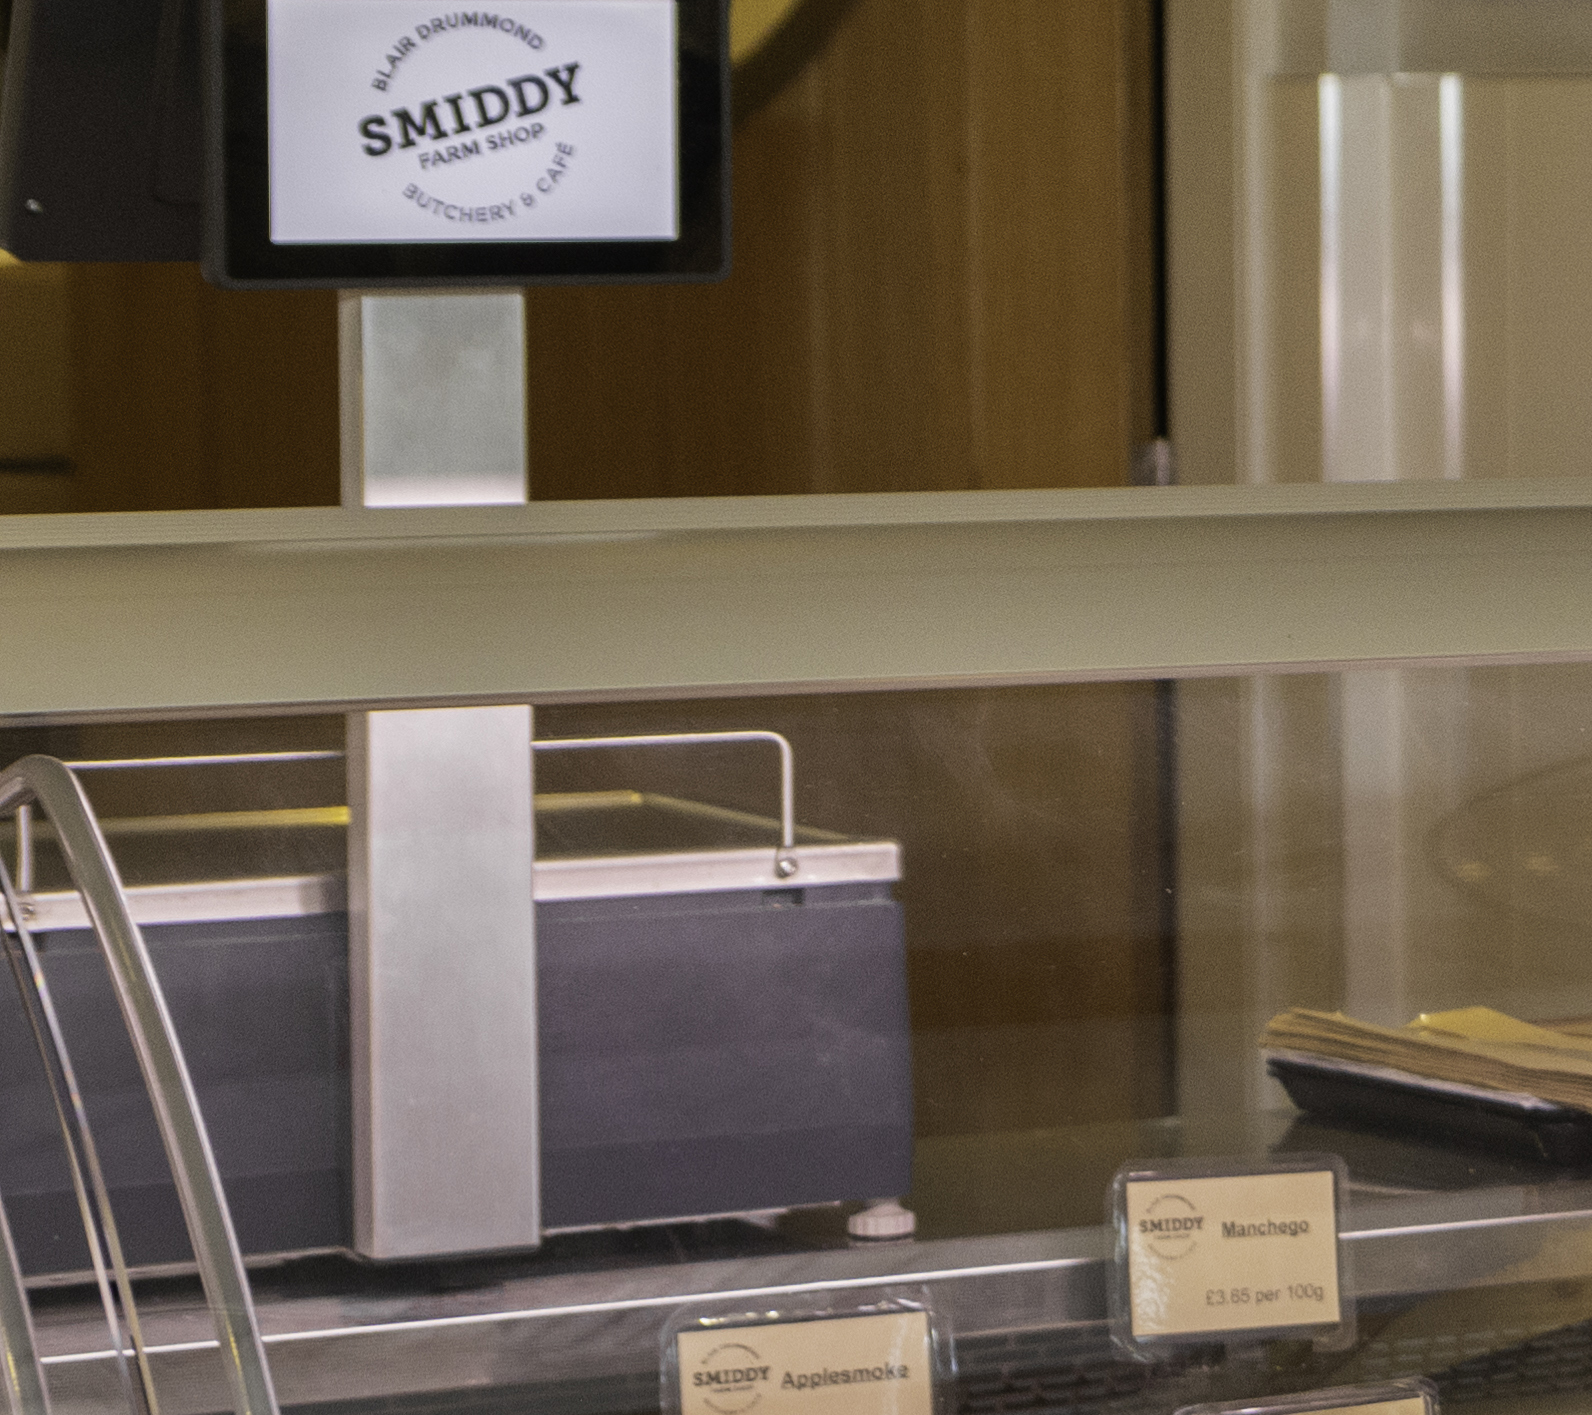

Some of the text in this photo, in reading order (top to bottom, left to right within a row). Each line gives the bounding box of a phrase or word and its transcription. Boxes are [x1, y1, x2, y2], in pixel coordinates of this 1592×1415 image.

[372, 11, 547, 93] BLAIR DRUMMOND
[358, 62, 584, 159] SMIDDY
[418, 121, 547, 170] FARM SHOP
[401, 182, 517, 224] BUTCHERY
[1139, 1216, 1309, 1239] SMIDDY Manchego
[1255, 1284, 1324, 1305] per 100g
[693, 1361, 909, 1391] SMIDDY Applesmoke
